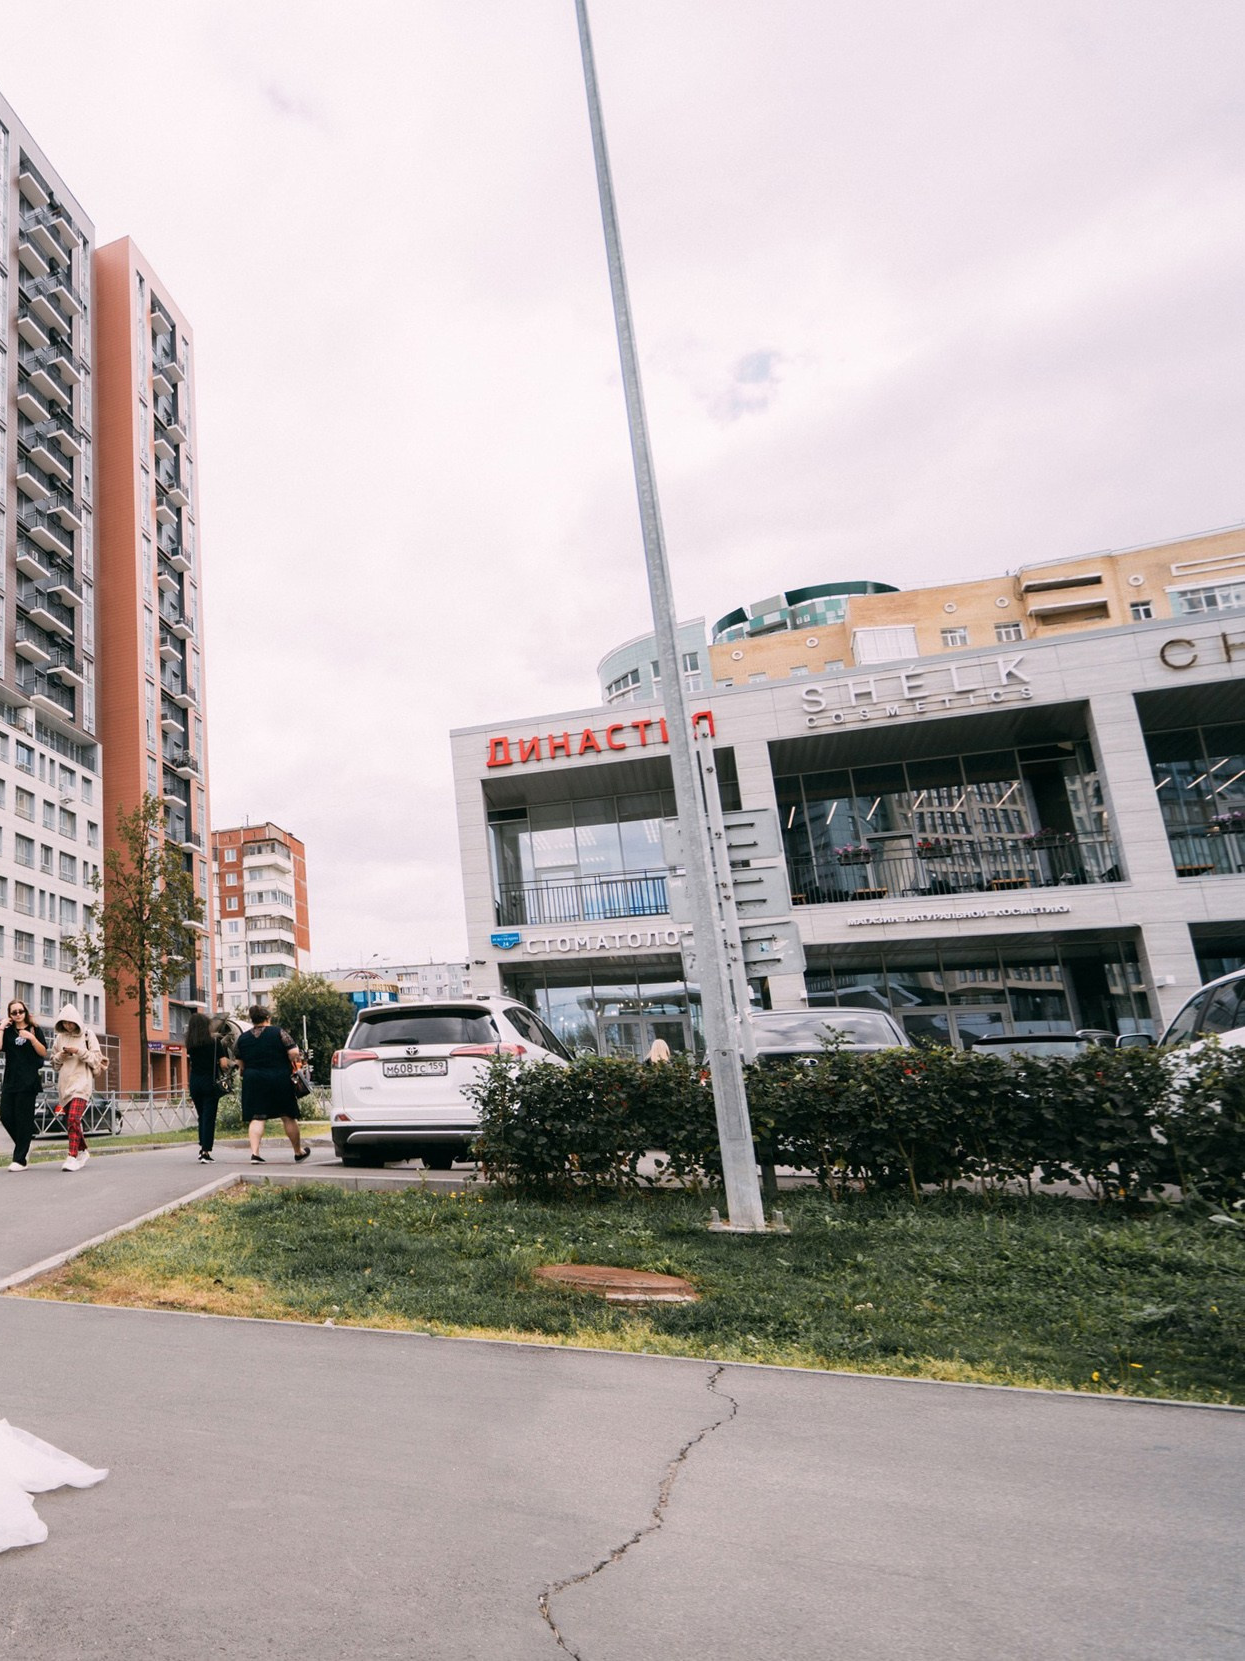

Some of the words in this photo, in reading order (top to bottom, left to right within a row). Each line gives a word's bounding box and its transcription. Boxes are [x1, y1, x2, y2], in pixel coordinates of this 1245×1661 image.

[806, 685, 1034, 729] COSMETICS
[847, 915, 900, 927] МАГАЗИН
[904, 909, 988, 923] НАТУРАЛЬНОЙ
[994, 904, 1073, 918] КОСМЕТИКИ
[526, 928, 693, 955] СТОМАТОЛО
